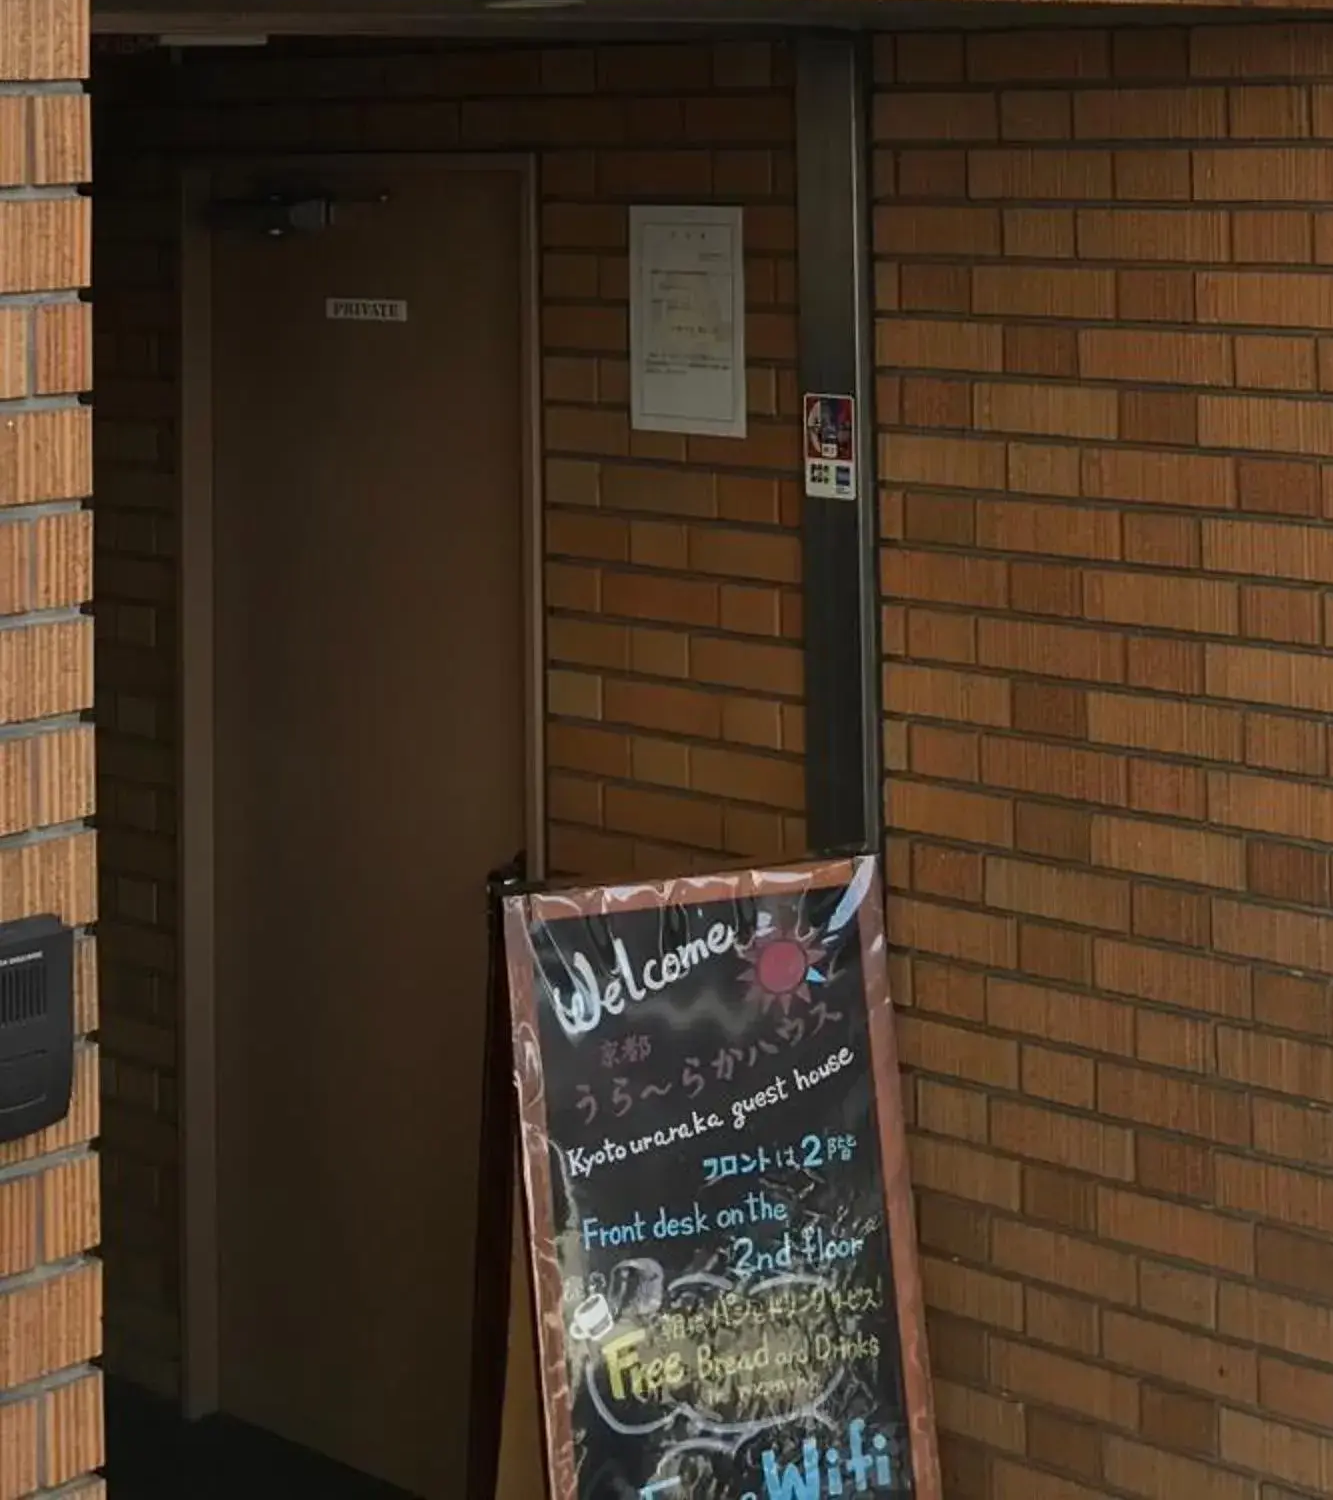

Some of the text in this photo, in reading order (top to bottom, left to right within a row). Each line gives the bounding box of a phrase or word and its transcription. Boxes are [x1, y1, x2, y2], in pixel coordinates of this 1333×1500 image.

[333, 301, 400, 318] PRIVATE
[553, 921, 734, 1034] Welcome
[567, 1046, 854, 1177] Kyoto uraraka guest house
[582, 1190, 789, 1251] Front desk on the
[732, 1225, 865, 1273] 2nd floor
[602, 1328, 685, 1401] Free
[696, 1341, 769, 1380] Bread
[814, 1331, 881, 1362] Drinks
